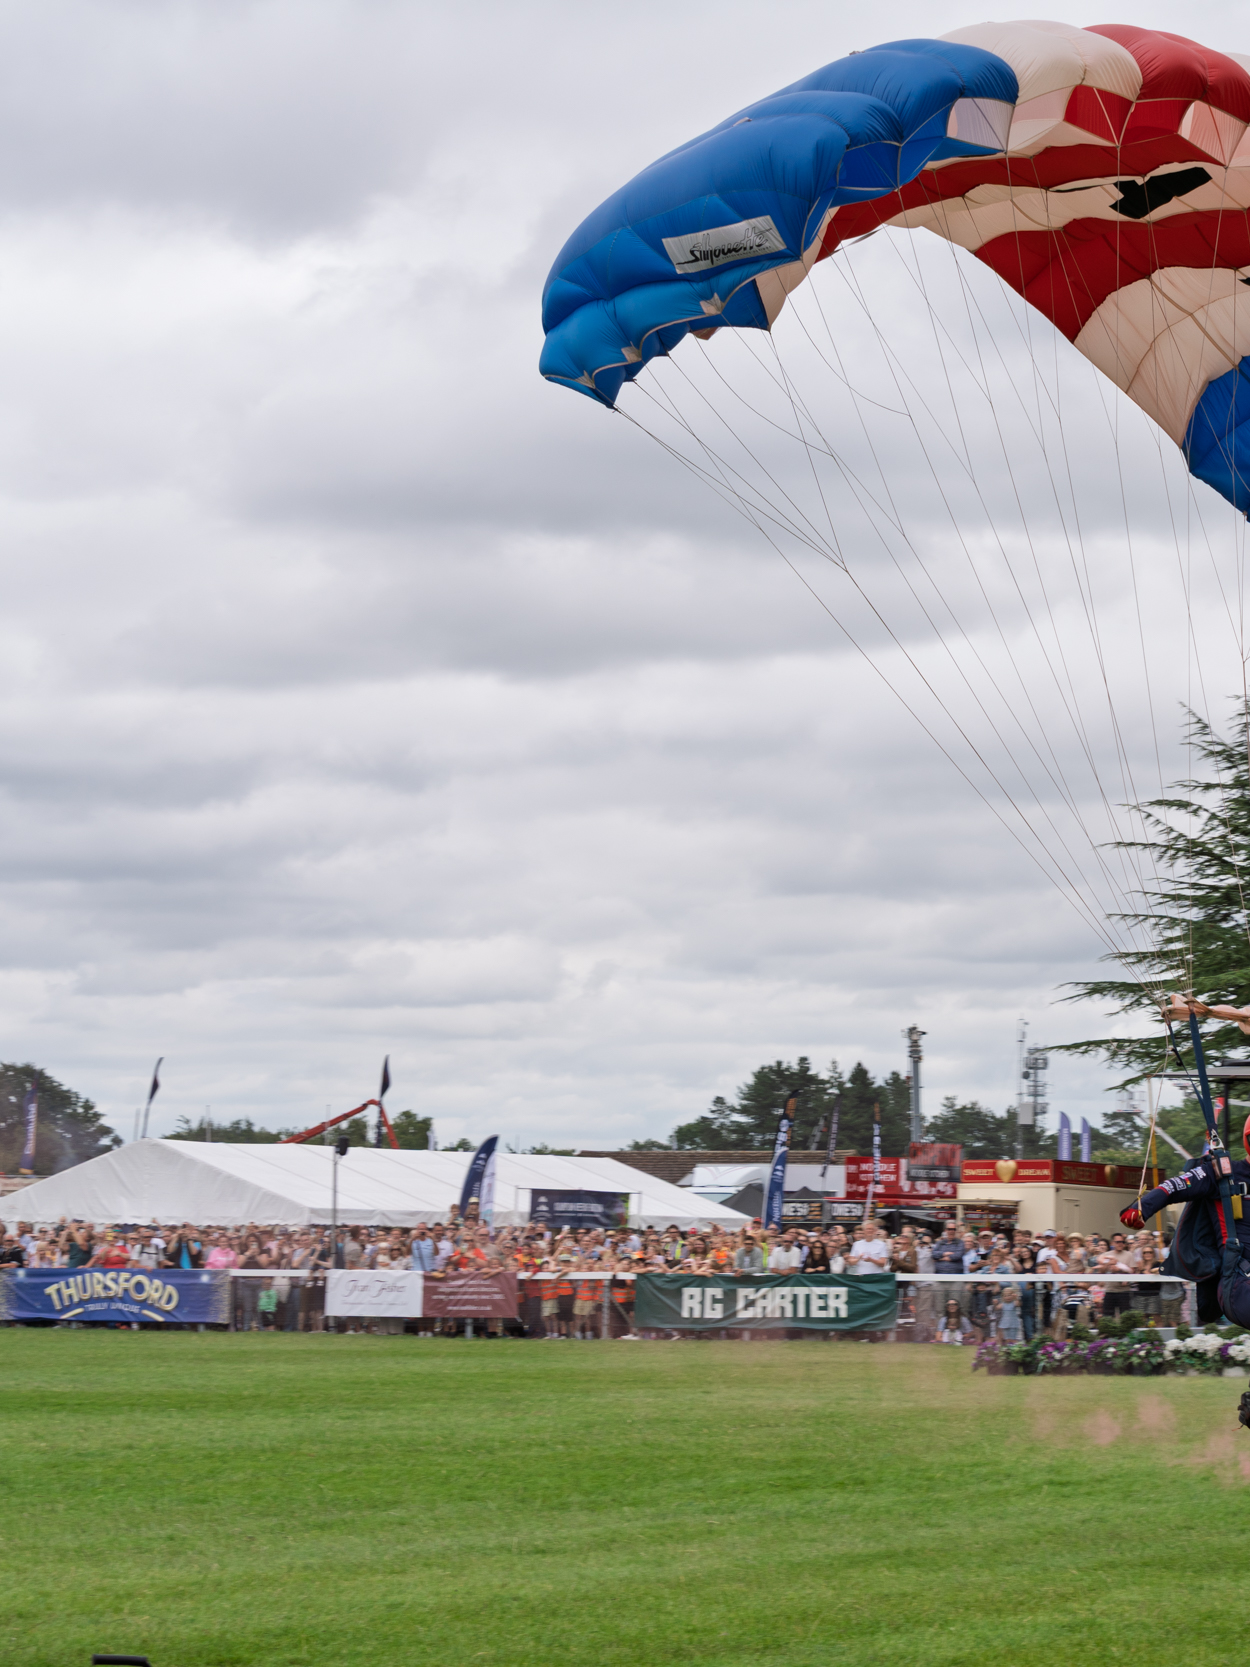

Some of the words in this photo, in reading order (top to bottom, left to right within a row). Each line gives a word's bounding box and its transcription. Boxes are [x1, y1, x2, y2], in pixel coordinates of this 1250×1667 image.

[675, 226, 773, 266] Silhouette
[859, 1163, 898, 1172] NODLE
[963, 1168, 994, 1176] SWEET
[1018, 1168, 1051, 1176] DREAM
[1061, 1166, 1098, 1183] SWEET
[859, 1173, 898, 1182] KITHEN
[44, 1271, 180, 1311] THURSFORD
[681, 1286, 724, 1319] RG
[737, 1286, 849, 1319] CARTER
